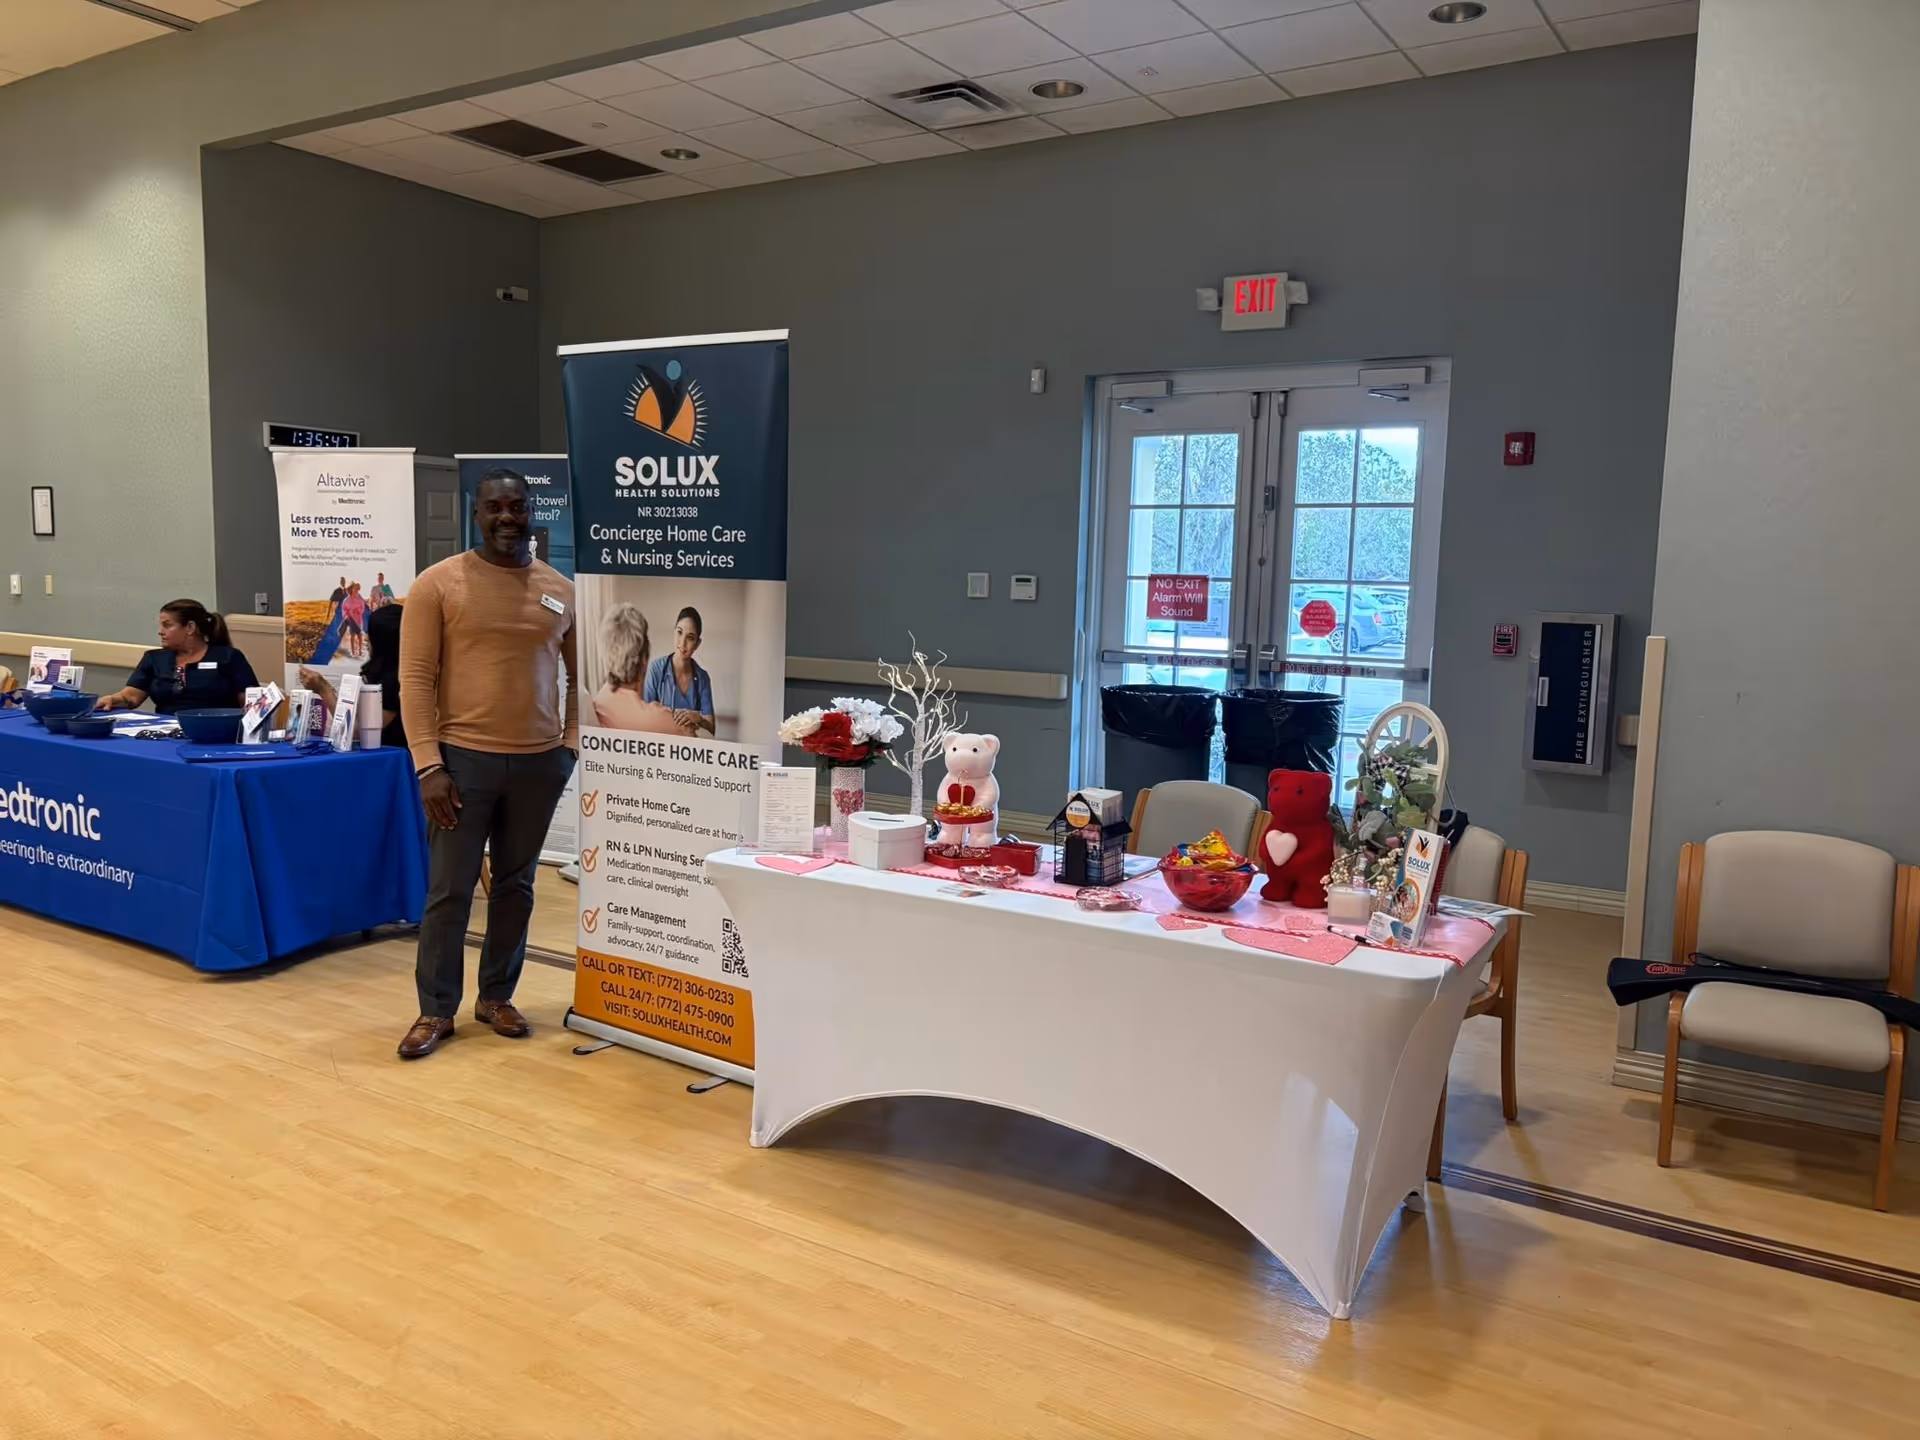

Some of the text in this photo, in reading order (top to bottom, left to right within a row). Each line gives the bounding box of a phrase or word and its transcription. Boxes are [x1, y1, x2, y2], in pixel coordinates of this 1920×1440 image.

[1235, 278, 1278, 314] EXIT
[524, 475, 551, 484] tronic
[615, 455, 720, 486] SOLUX
[536, 494, 567, 506] bowel
[615, 488, 720, 497] HEALTH SOLUTIONS
[291, 513, 311, 524] Less
[637, 506, 698, 518] NR 30213038
[291, 527, 373, 539] More YES room.
[590, 523, 747, 544] Concierge Home Care
[601, 548, 735, 569] & Nursing Services
[1156, 578, 1201, 589] NO EXIT
[1152, 592, 1204, 603] Alarm Will
[1161, 606, 1193, 616] Sound
[1575, 630, 1593, 760] FIRE EXTINGUISHER
[581, 735, 759, 770] CONCIERGE HOME CARE
[585, 760, 751, 793] Elite Nursing & Personalized Support
[0, 781, 101, 841] edtronic
[606, 793, 691, 816] Private Home Care
[606, 810, 645, 827] Dignified,
[646, 817, 693, 833] personalized
[694, 826, 711, 836] care
[712, 829, 720, 838] at
[0, 839, 134, 890] eering the extraordinary
[606, 840, 705, 867] RN & LPN Nursing Ser
[1407, 856, 1431, 871] SOLUX
[606, 857, 651, 873] Medication
[652, 865, 702, 885] management,
[606, 874, 689, 898] care, clinical oversight
[607, 902, 687, 928] Care Management
[607, 918, 716, 953] Family-support, coordination,
[607, 935, 700, 965] advocacy, 24/7 guidance
[582, 956, 735, 1006] CALL OR TEXT: (772) 306-0233
[601, 981, 734, 1028] CALL 24/7: (772) 475-0900
[604, 1000, 732, 1047] VISIT: SOLUXHEALTH.COM
